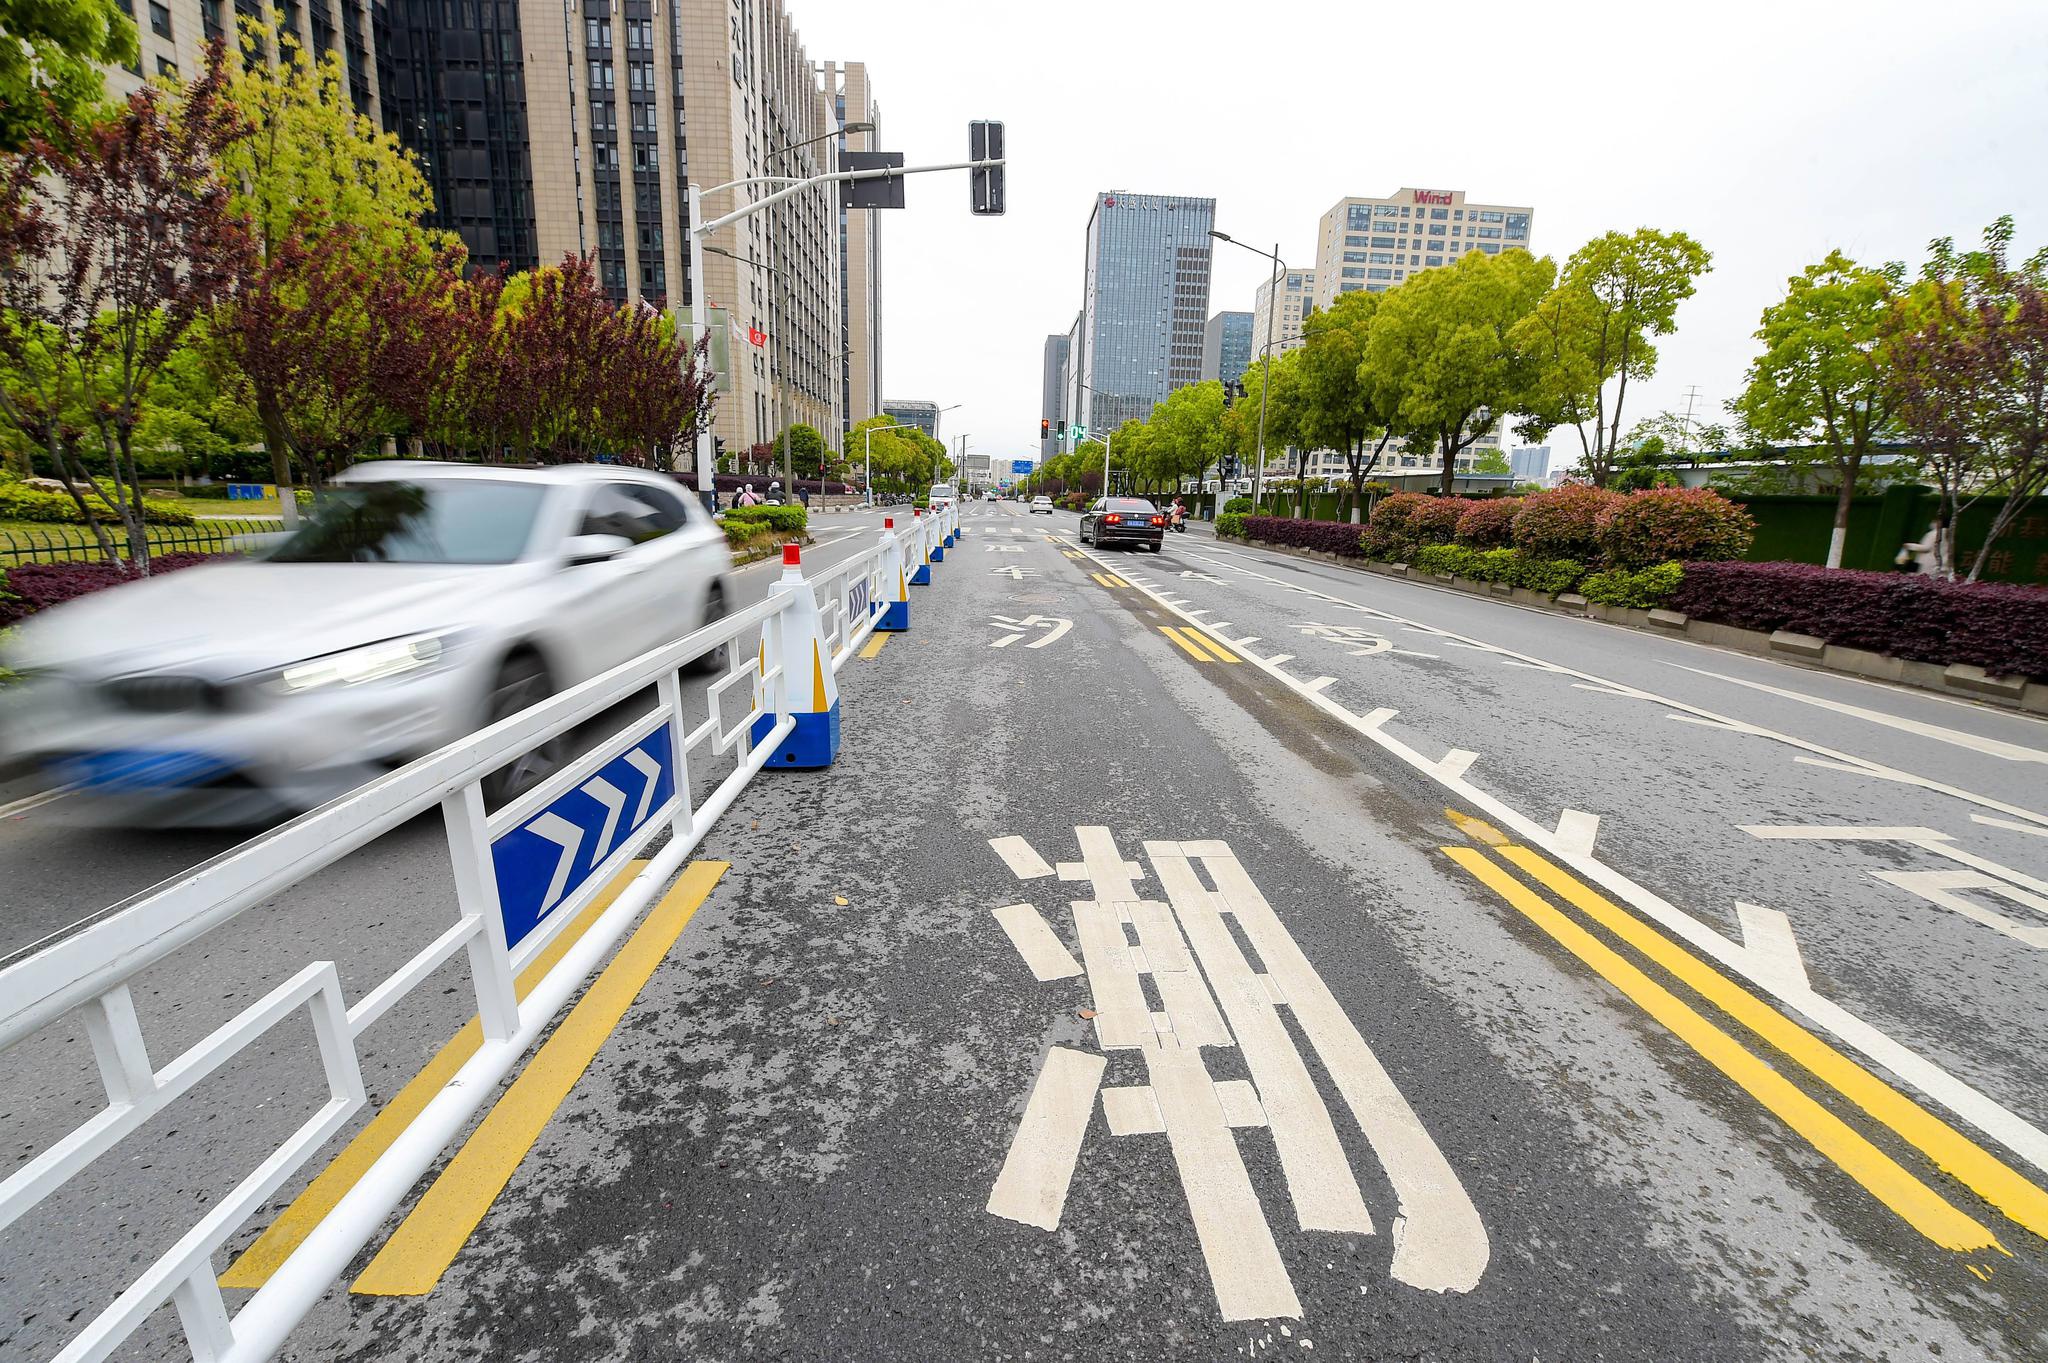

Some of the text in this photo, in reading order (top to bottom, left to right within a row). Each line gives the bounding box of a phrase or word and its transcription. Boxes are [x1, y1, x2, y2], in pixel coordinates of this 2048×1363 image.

[1070, 426, 1086, 439] 04
[988, 614, 1074, 649] 汐
[986, 825, 1490, 1322] 潮
